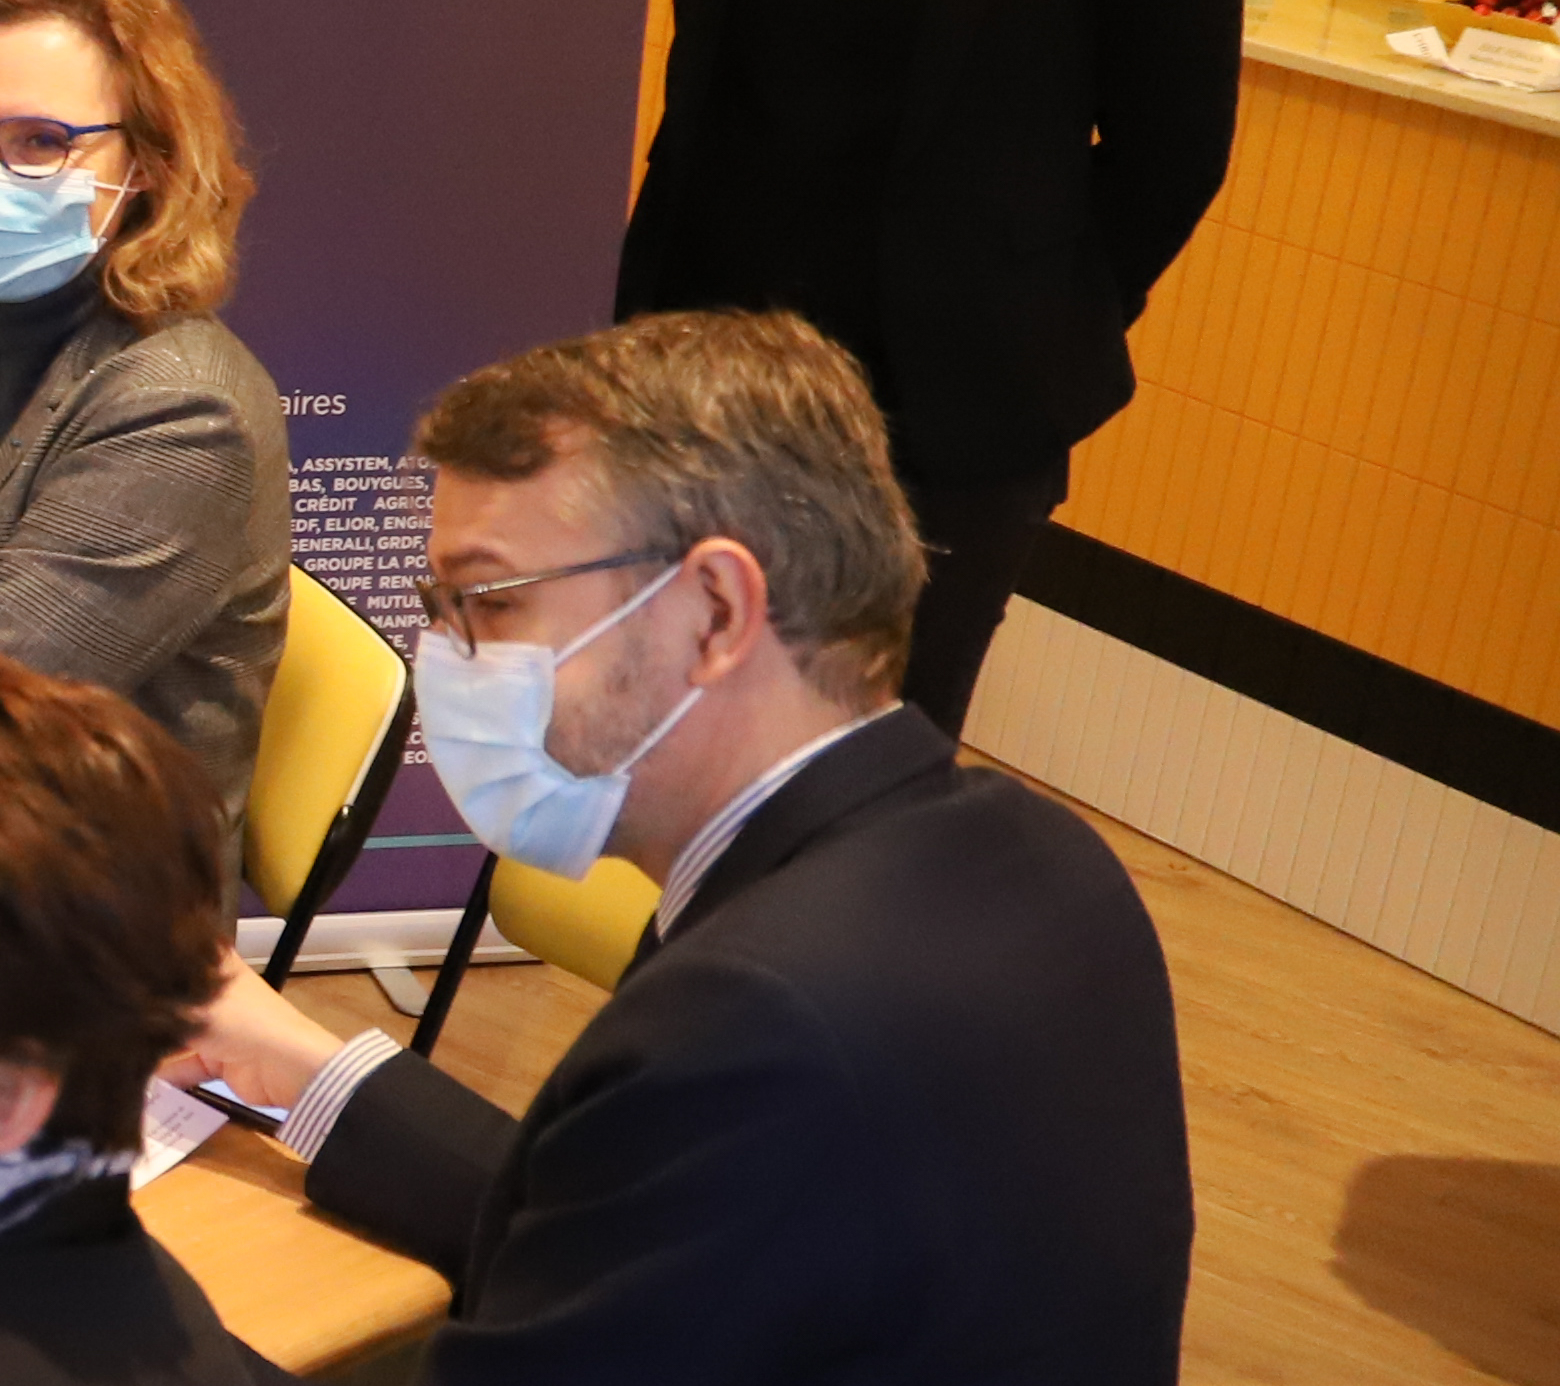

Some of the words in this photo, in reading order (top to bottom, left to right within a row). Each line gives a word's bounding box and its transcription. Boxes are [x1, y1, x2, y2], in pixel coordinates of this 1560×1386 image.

[279, 389, 347, 415] aires
[301, 456, 394, 474] ASSYSTEM,
[288, 477, 326, 494] BAS,
[333, 476, 429, 492] BOUYGUES,
[294, 494, 358, 513] CRÉDIT
[325, 517, 380, 533] ELIOR,
[377, 535, 426, 551] GRDF,
[304, 556, 374, 573] GROUPE
[377, 555, 400, 570] LA
[321, 575, 373, 591] OUPE
